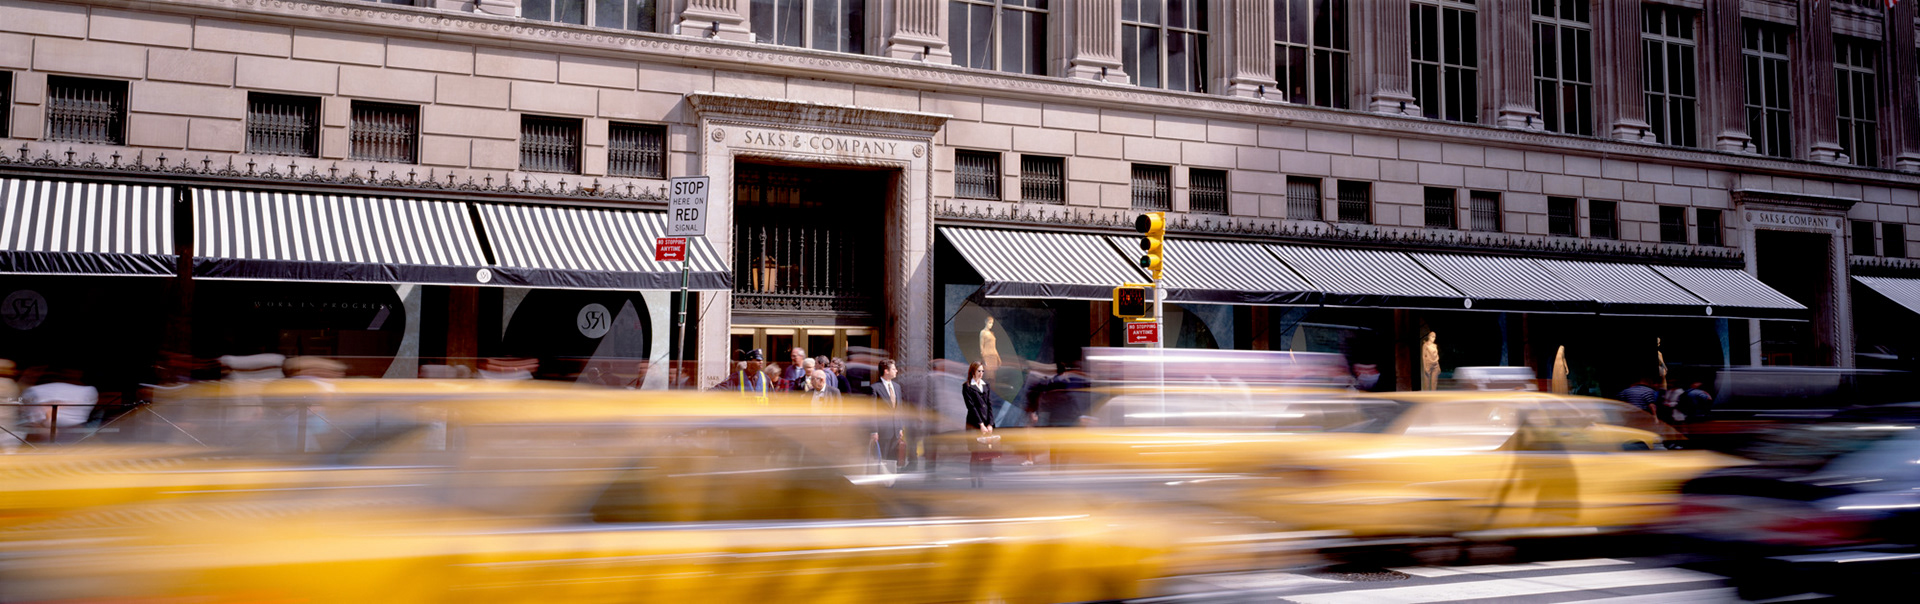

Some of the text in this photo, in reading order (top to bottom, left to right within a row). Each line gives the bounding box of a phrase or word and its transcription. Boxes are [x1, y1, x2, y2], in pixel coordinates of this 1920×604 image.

[744, 130, 898, 156] SAKS & COMPANY
[674, 181, 704, 195] STOP
[694, 197, 704, 205] ON
[675, 208, 699, 221] RED
[1759, 212, 1829, 227] SAKS & COMPANY
[323, 302, 393, 310] PROGRESS
